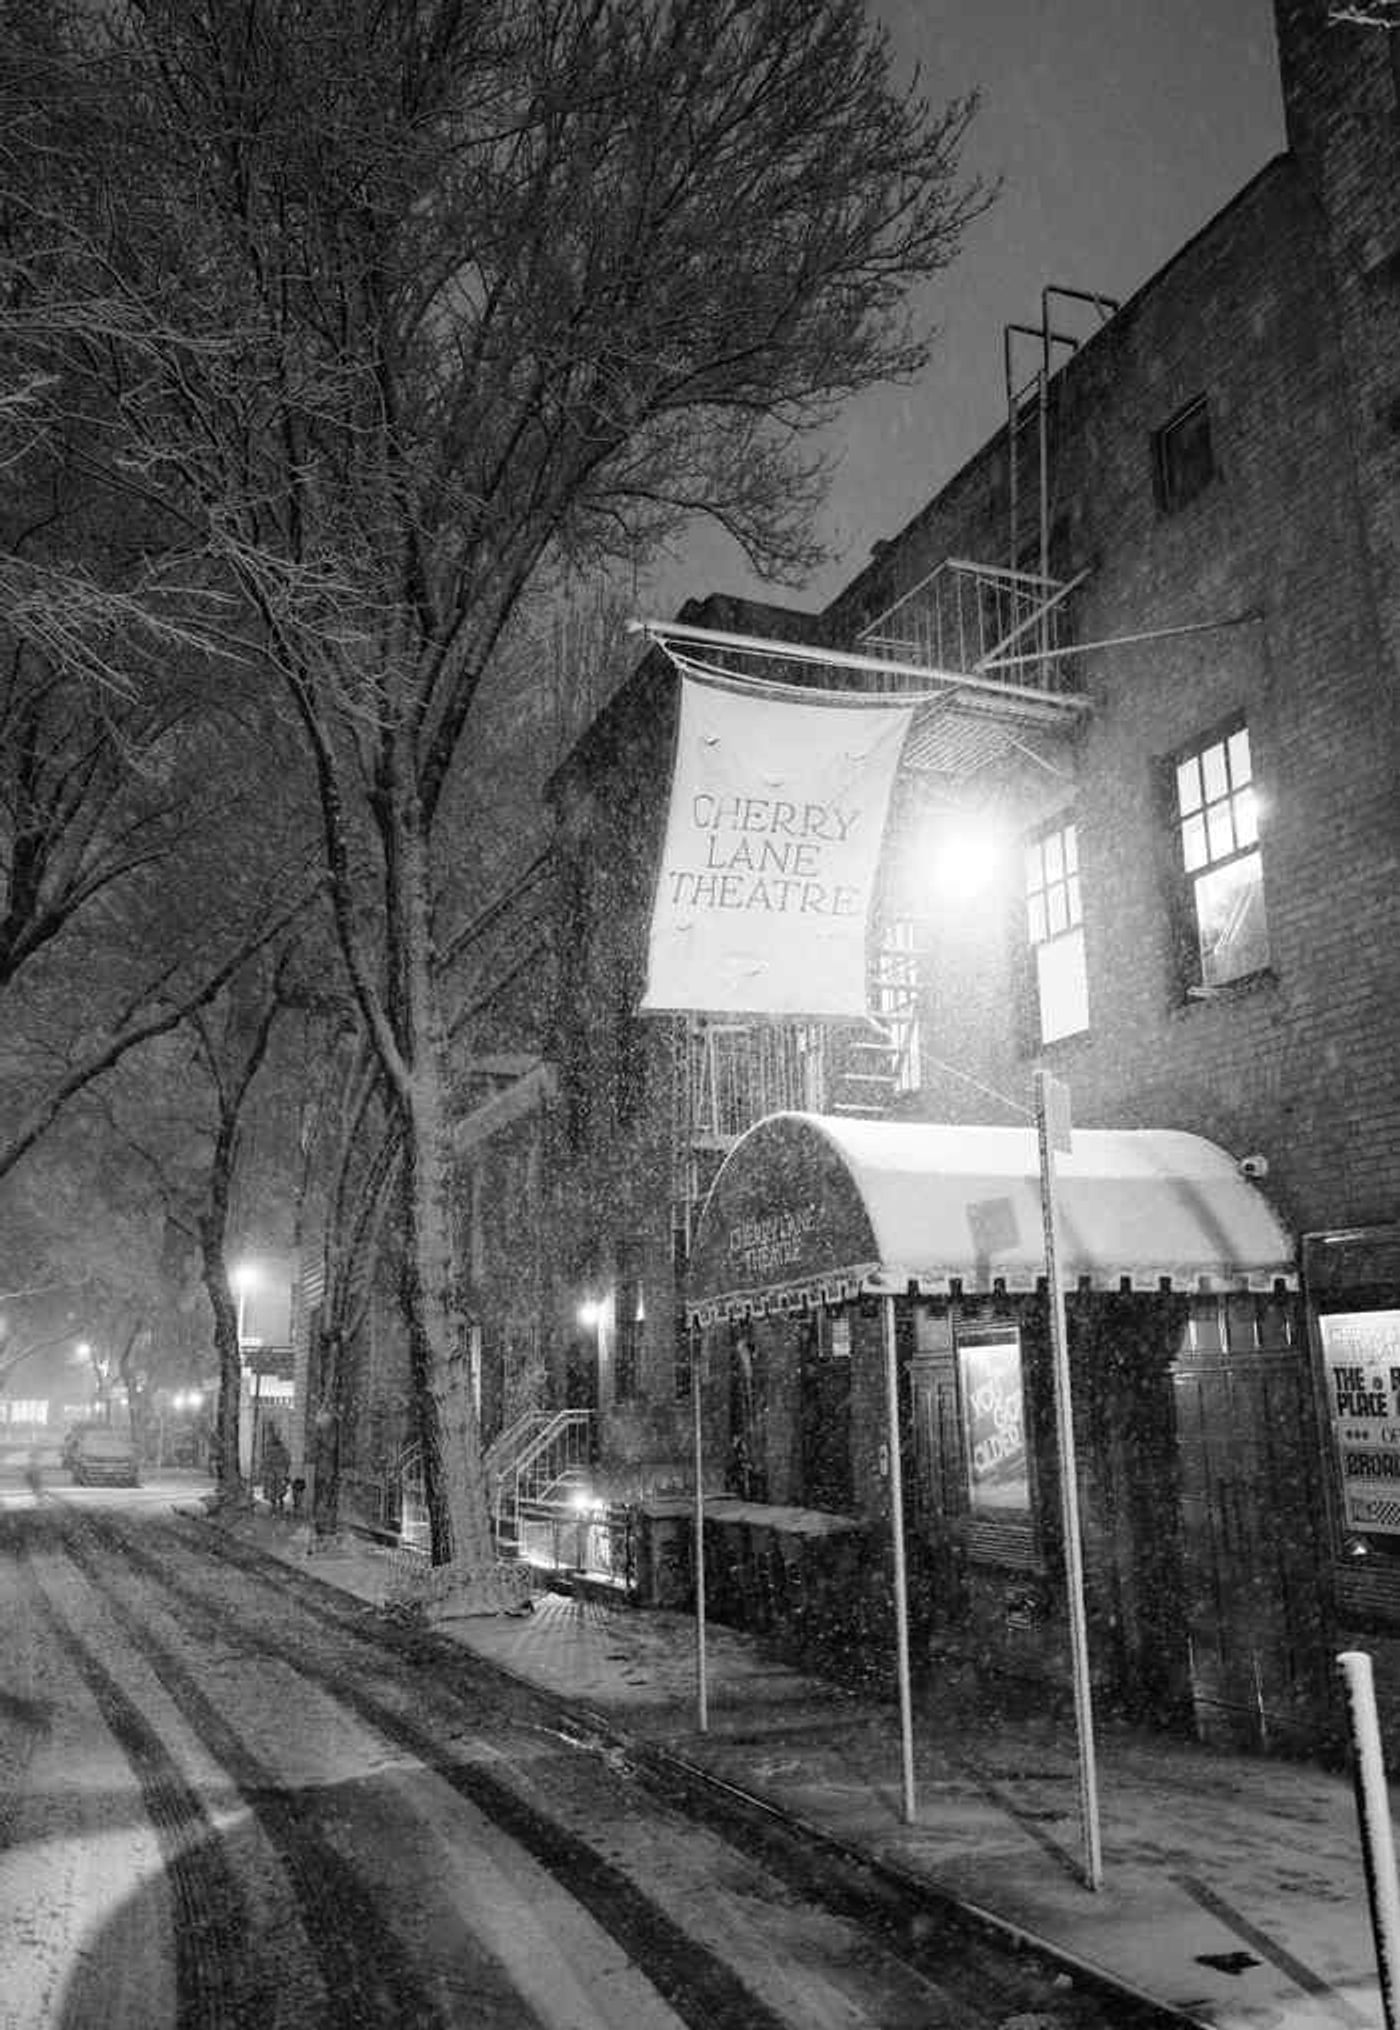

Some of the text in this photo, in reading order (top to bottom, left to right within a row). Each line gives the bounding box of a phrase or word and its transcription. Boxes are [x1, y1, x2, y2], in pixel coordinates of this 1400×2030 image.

[693, 794, 860, 841] CHERRY
[706, 835, 820, 877] LANE
[669, 871, 860, 915] THEATRE
[1333, 1367, 1365, 1391] THE
[1336, 1391, 1388, 1417] PLACE
